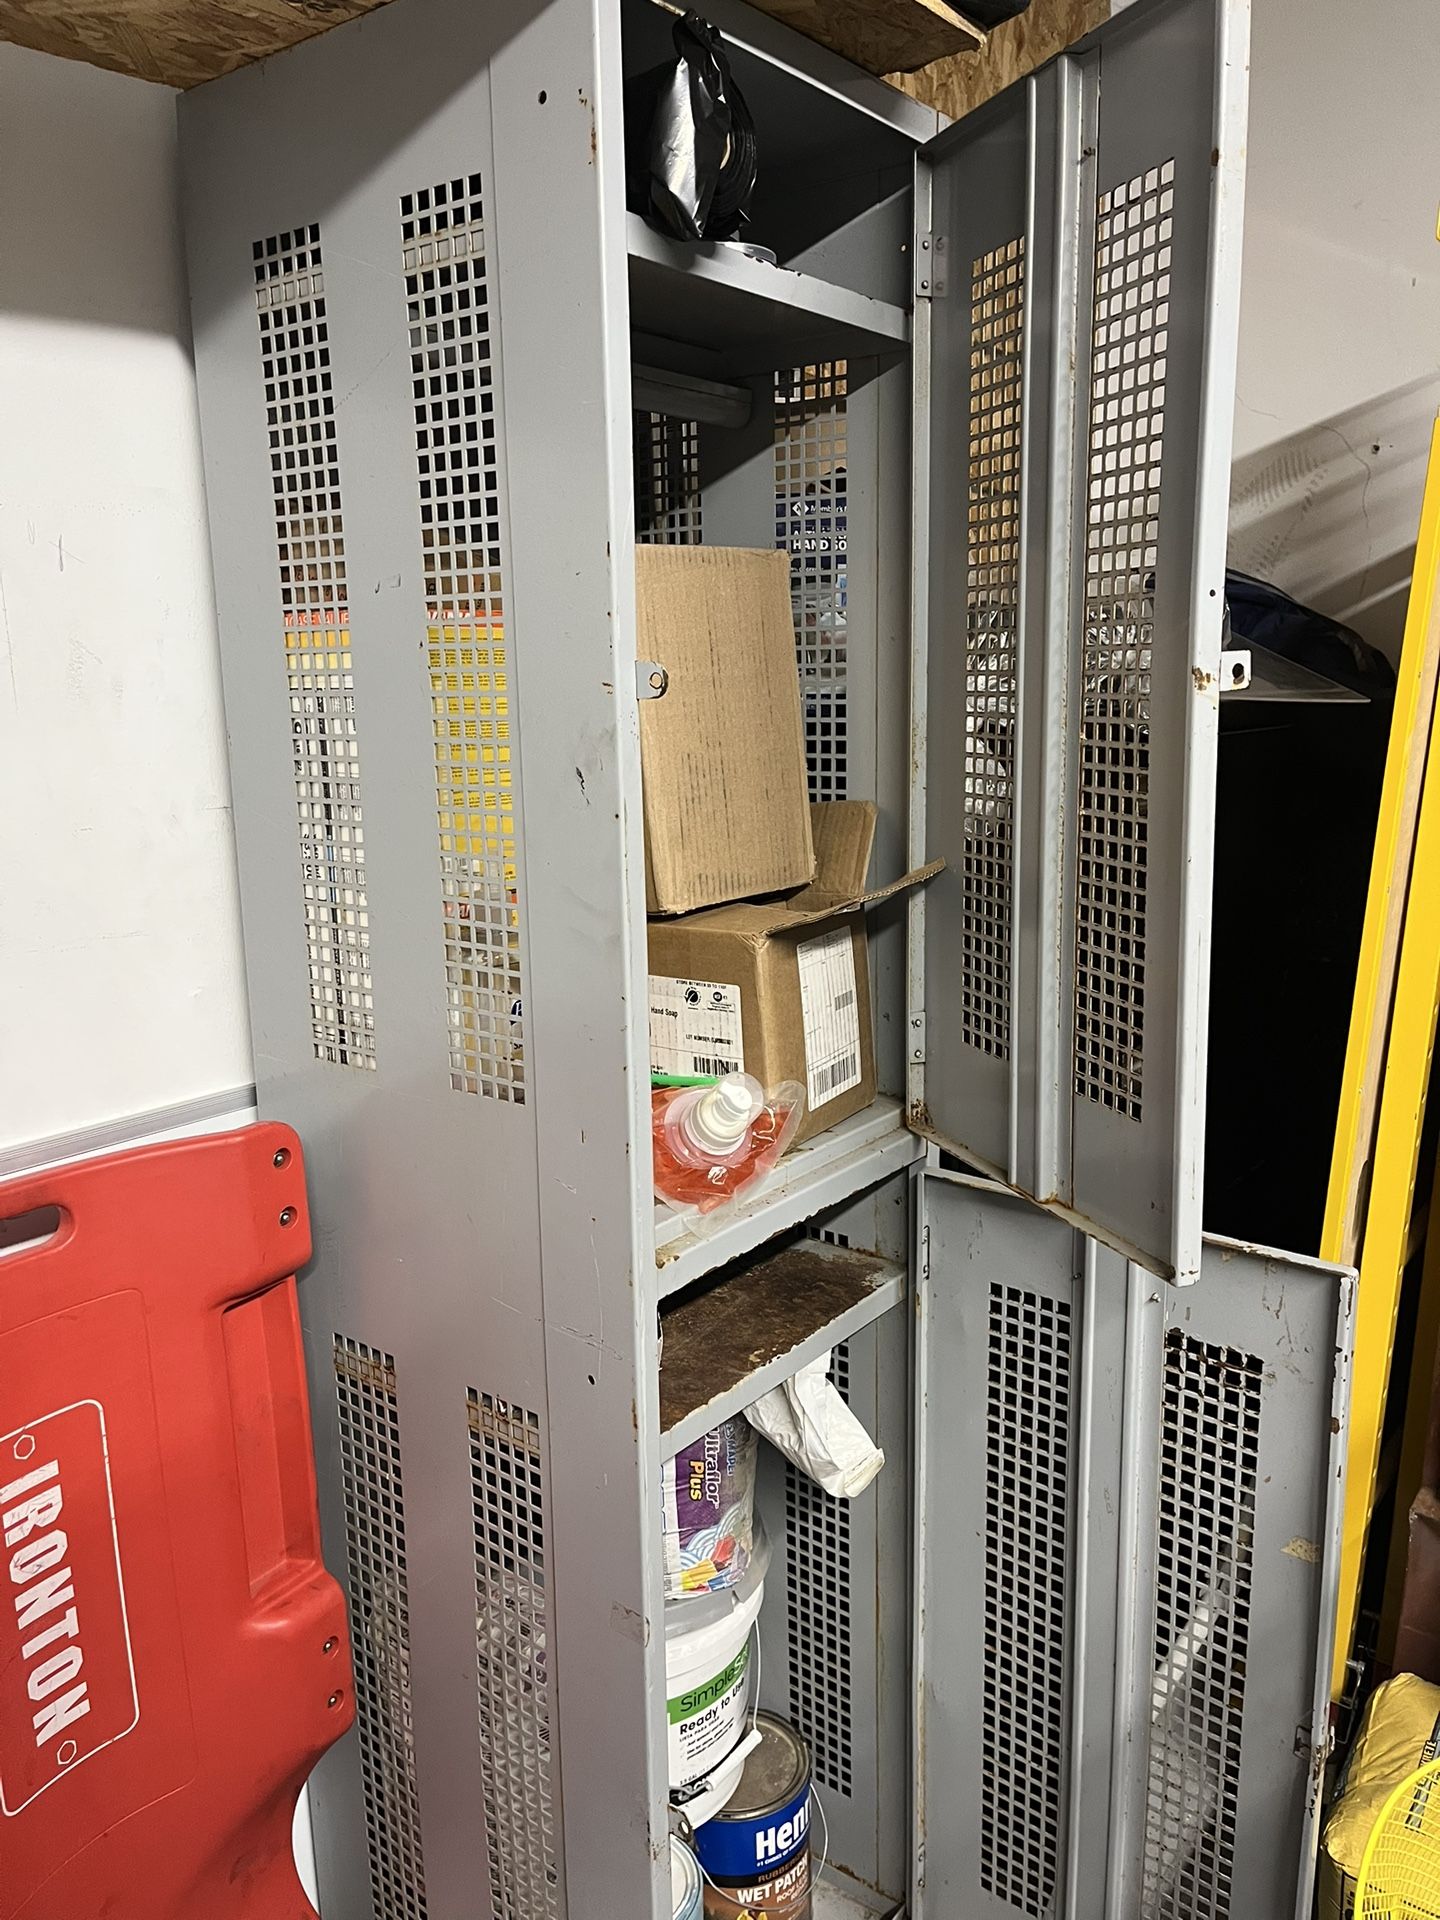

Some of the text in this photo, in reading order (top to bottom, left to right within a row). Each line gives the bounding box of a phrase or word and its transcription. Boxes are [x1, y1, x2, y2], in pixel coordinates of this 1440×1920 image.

[651, 1006, 678, 1019] Hand Soap
[690, 1460, 704, 1500] Plus
[0, 1459, 91, 1747] IRONTON
[680, 1677, 745, 1735] Ready to Use
[737, 1849, 809, 1904] WET PATCH
[776, 1884, 796, 1903] ROOF
